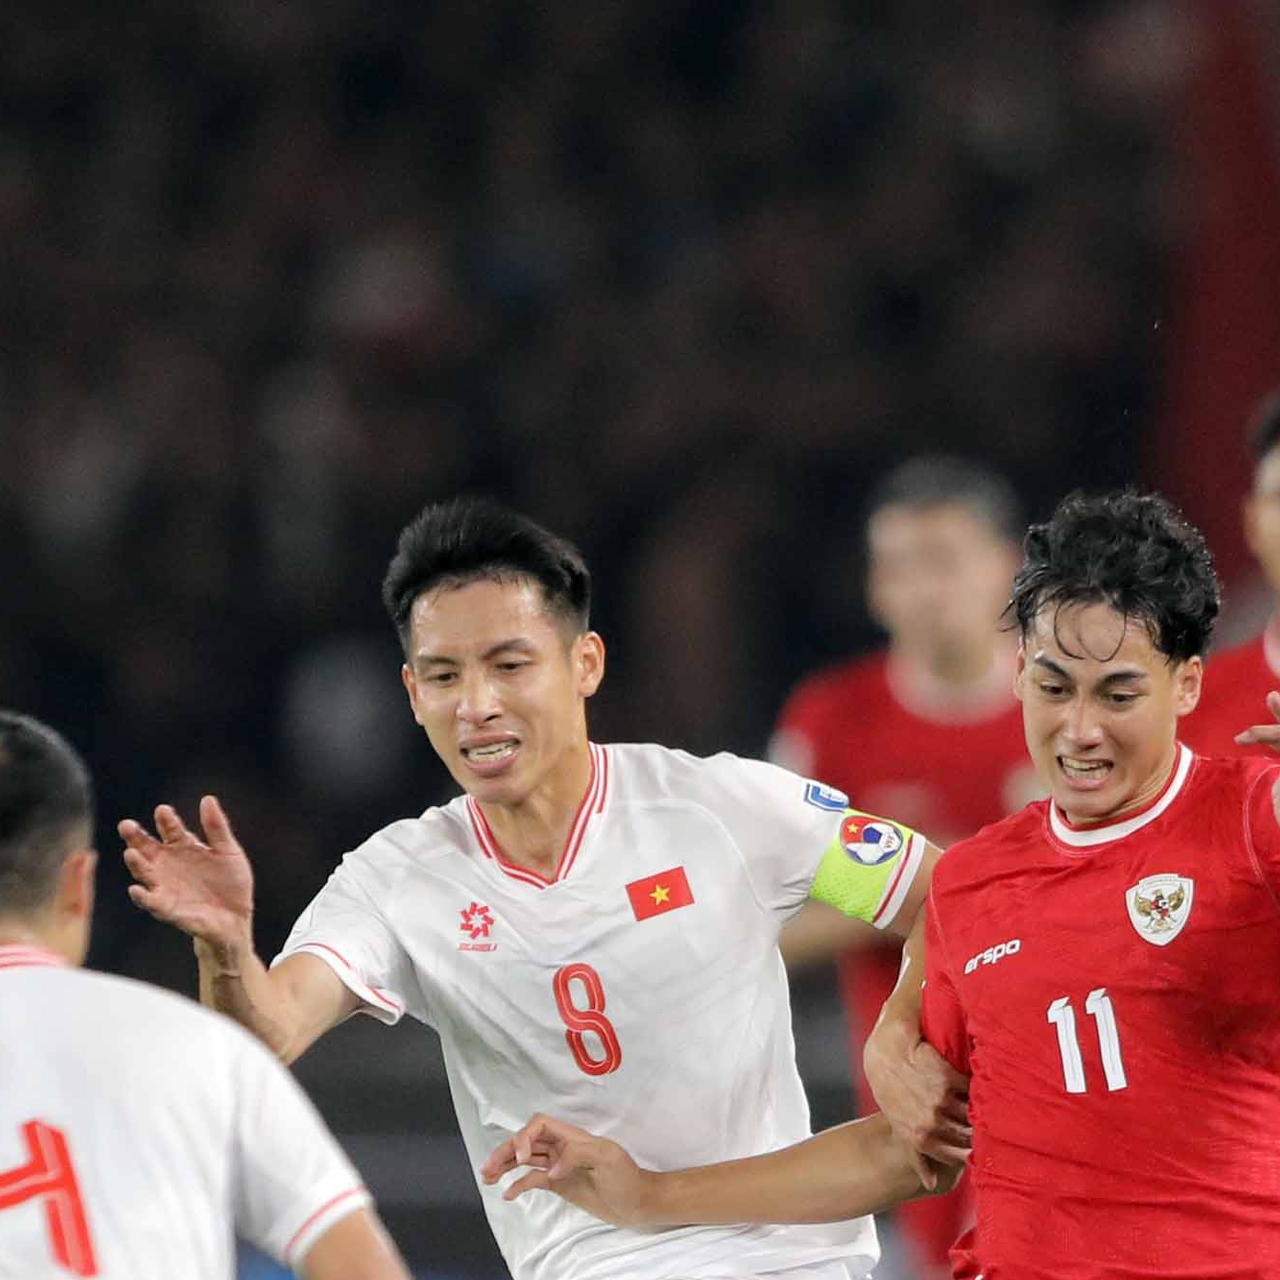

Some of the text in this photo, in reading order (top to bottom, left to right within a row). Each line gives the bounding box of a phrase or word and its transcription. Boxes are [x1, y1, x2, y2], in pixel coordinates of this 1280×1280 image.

[964, 939, 1021, 974] erspo
[553, 963, 622, 1076] 8
[1047, 988, 1128, 1094] 11
